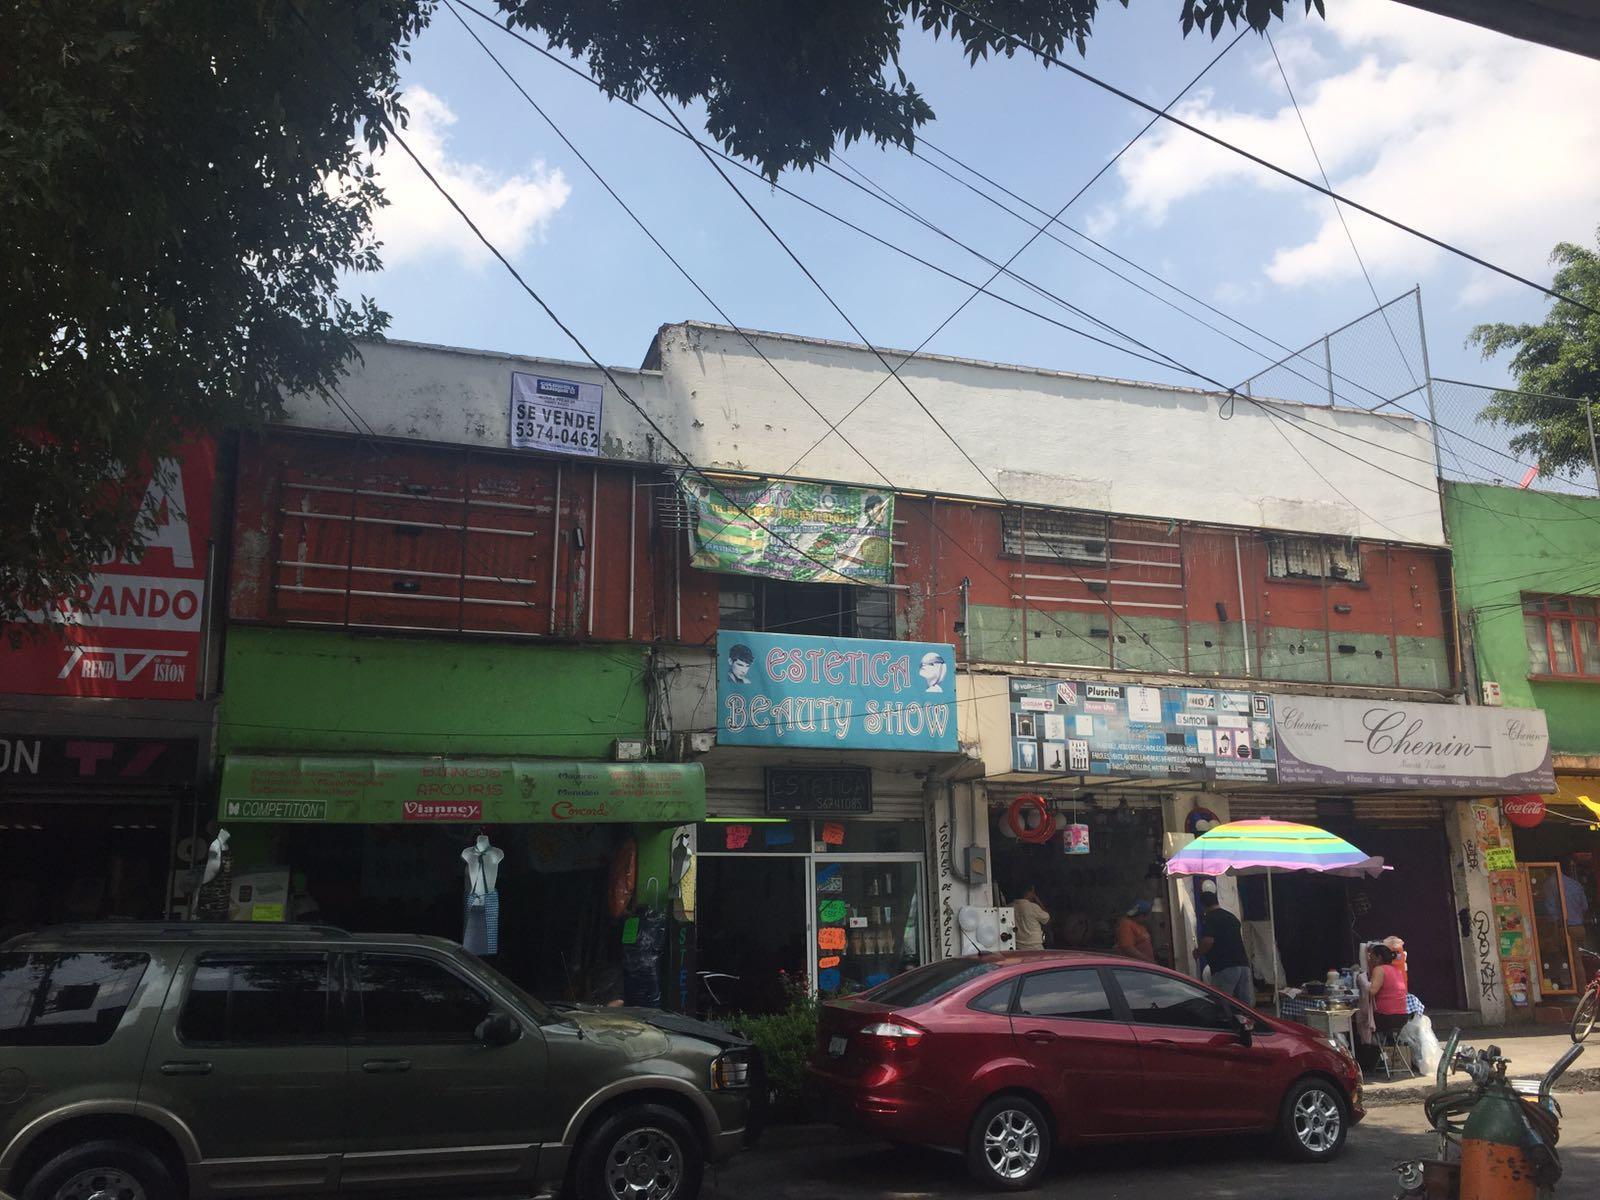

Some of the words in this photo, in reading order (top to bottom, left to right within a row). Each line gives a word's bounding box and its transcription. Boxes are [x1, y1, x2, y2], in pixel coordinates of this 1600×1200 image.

[517, 404, 536, 420] SE
[542, 408, 595, 431] VENDE
[516, 422, 598, 448] 5374-0462
[765, 647, 912, 693] ESTETICA
[1087, 686, 1119, 697] Plusrite
[724, 693, 853, 740] BEAUTY
[863, 699, 950, 738] SHOW
[1182, 716, 1206, 725] simon
[1363, 708, 1475, 757] Chenin
[242, 801, 319, 818] COMPETITION
[404, 801, 478, 818] Vianney
